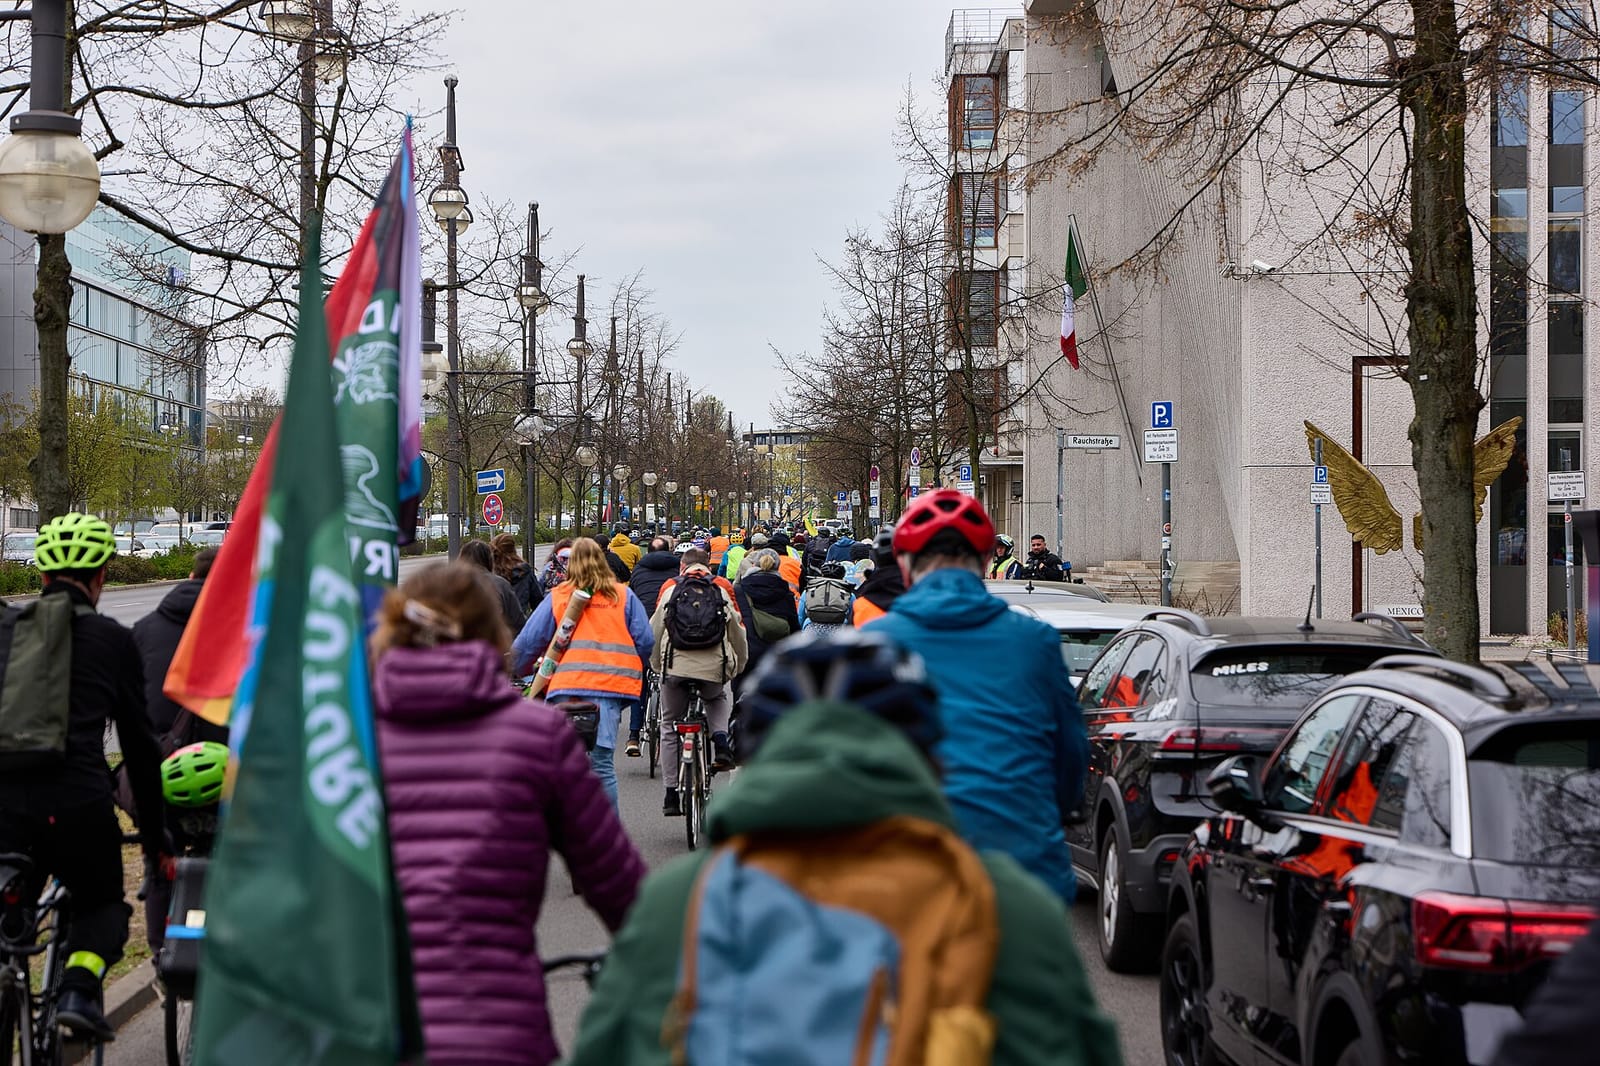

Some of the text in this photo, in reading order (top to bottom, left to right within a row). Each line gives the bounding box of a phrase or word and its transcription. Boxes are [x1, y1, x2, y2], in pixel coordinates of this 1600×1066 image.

[1155, 404, 1166, 425] P
[1072, 436, 1113, 447] Rauchstraße
[1317, 468, 1325, 481] P
[1212, 661, 1269, 677] MILES
